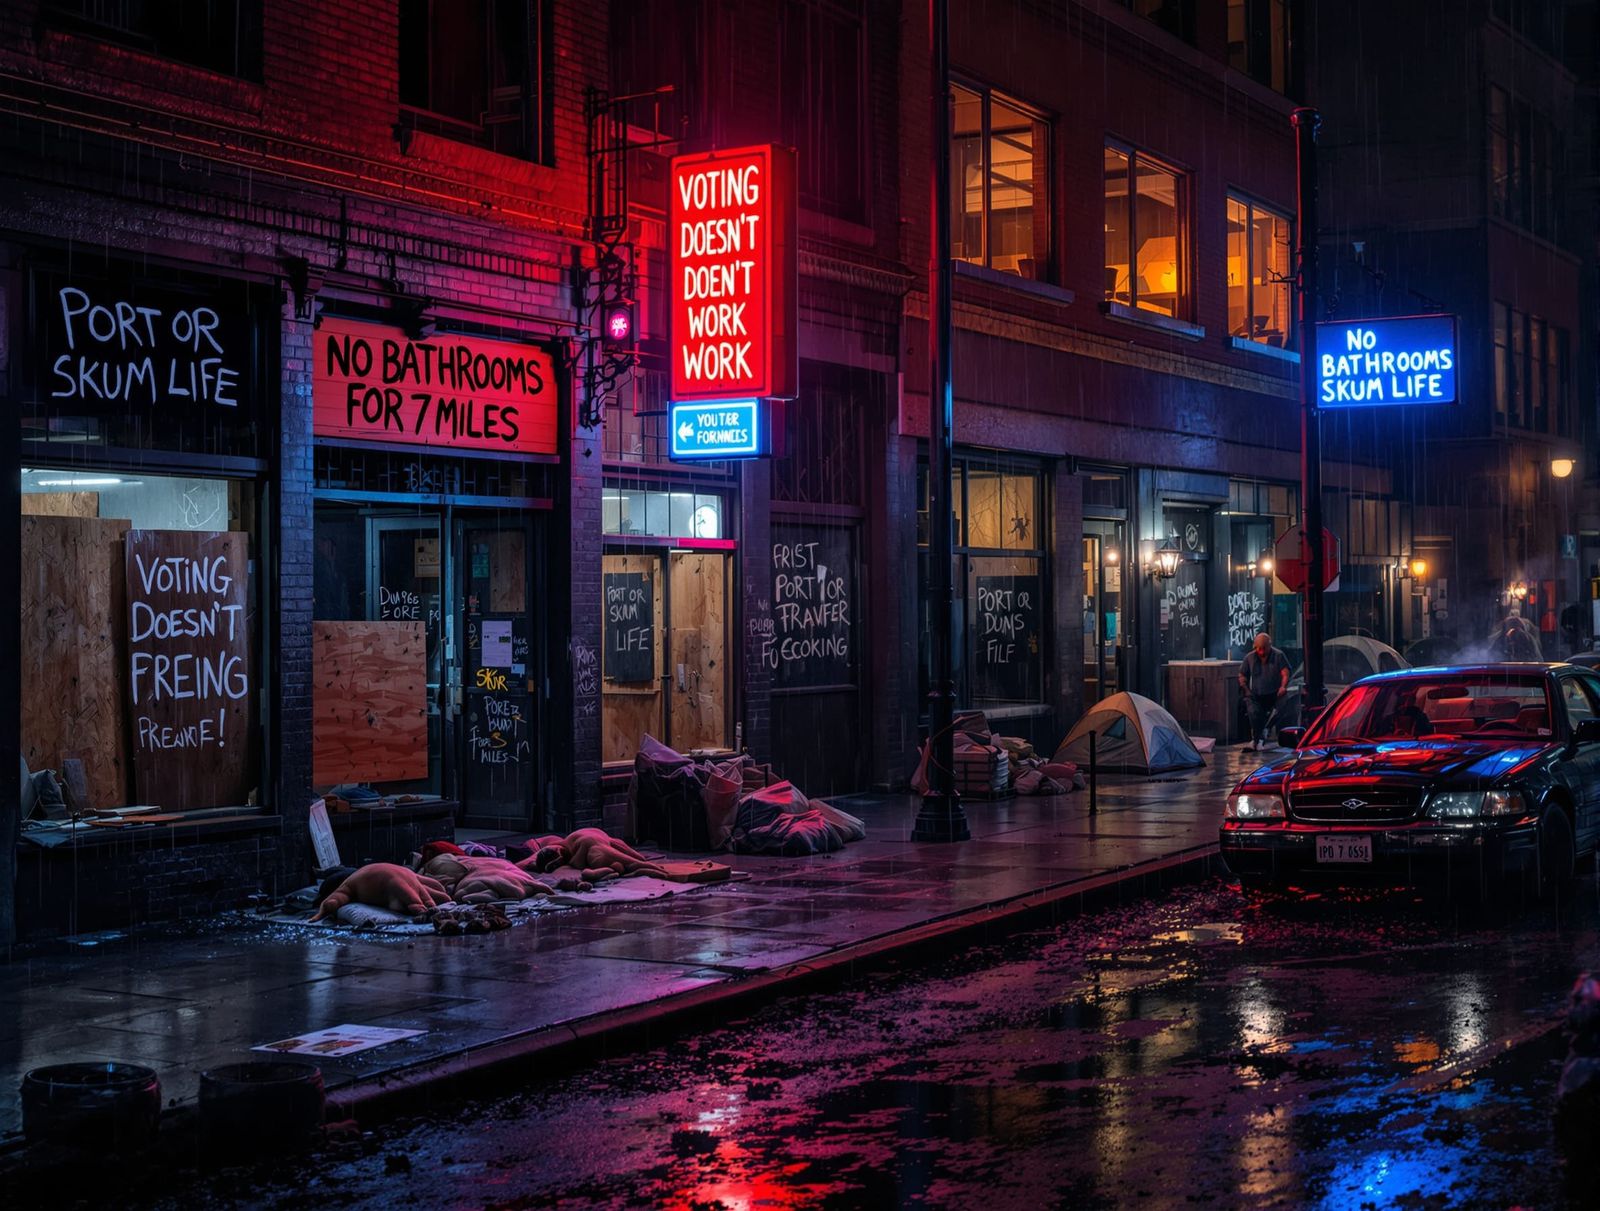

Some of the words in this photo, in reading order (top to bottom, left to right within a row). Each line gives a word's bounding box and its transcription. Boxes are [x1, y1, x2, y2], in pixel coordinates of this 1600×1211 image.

[678, 165, 759, 211] VOTING
[680, 213, 760, 258] DOESN'T
[683, 260, 756, 301] DOEN'T
[59, 287, 162, 350] PORT
[172, 307, 223, 354] OR
[687, 302, 747, 340] WORK
[1346, 328, 1376, 351] NO
[52, 355, 156, 404] SKUM
[168, 358, 240, 406] LIFE
[327, 335, 373, 377] NO
[382, 339, 544, 395] BATHROOMS
[682, 341, 753, 381] WORK
[1321, 349, 1453, 377] BATHROOMS
[1321, 377, 1384, 402] SKUM
[1392, 373, 1443, 398] LIFE
[347, 383, 404, 432] FOR
[411, 394, 432, 436] 7
[436, 397, 519, 442] MILES
[772, 542, 820, 570] FRIST
[775, 573, 816, 603] PORT
[978, 587, 1013, 612] PORT
[616, 626, 651, 652] LIFE
[131, 651, 249, 705] FREING
